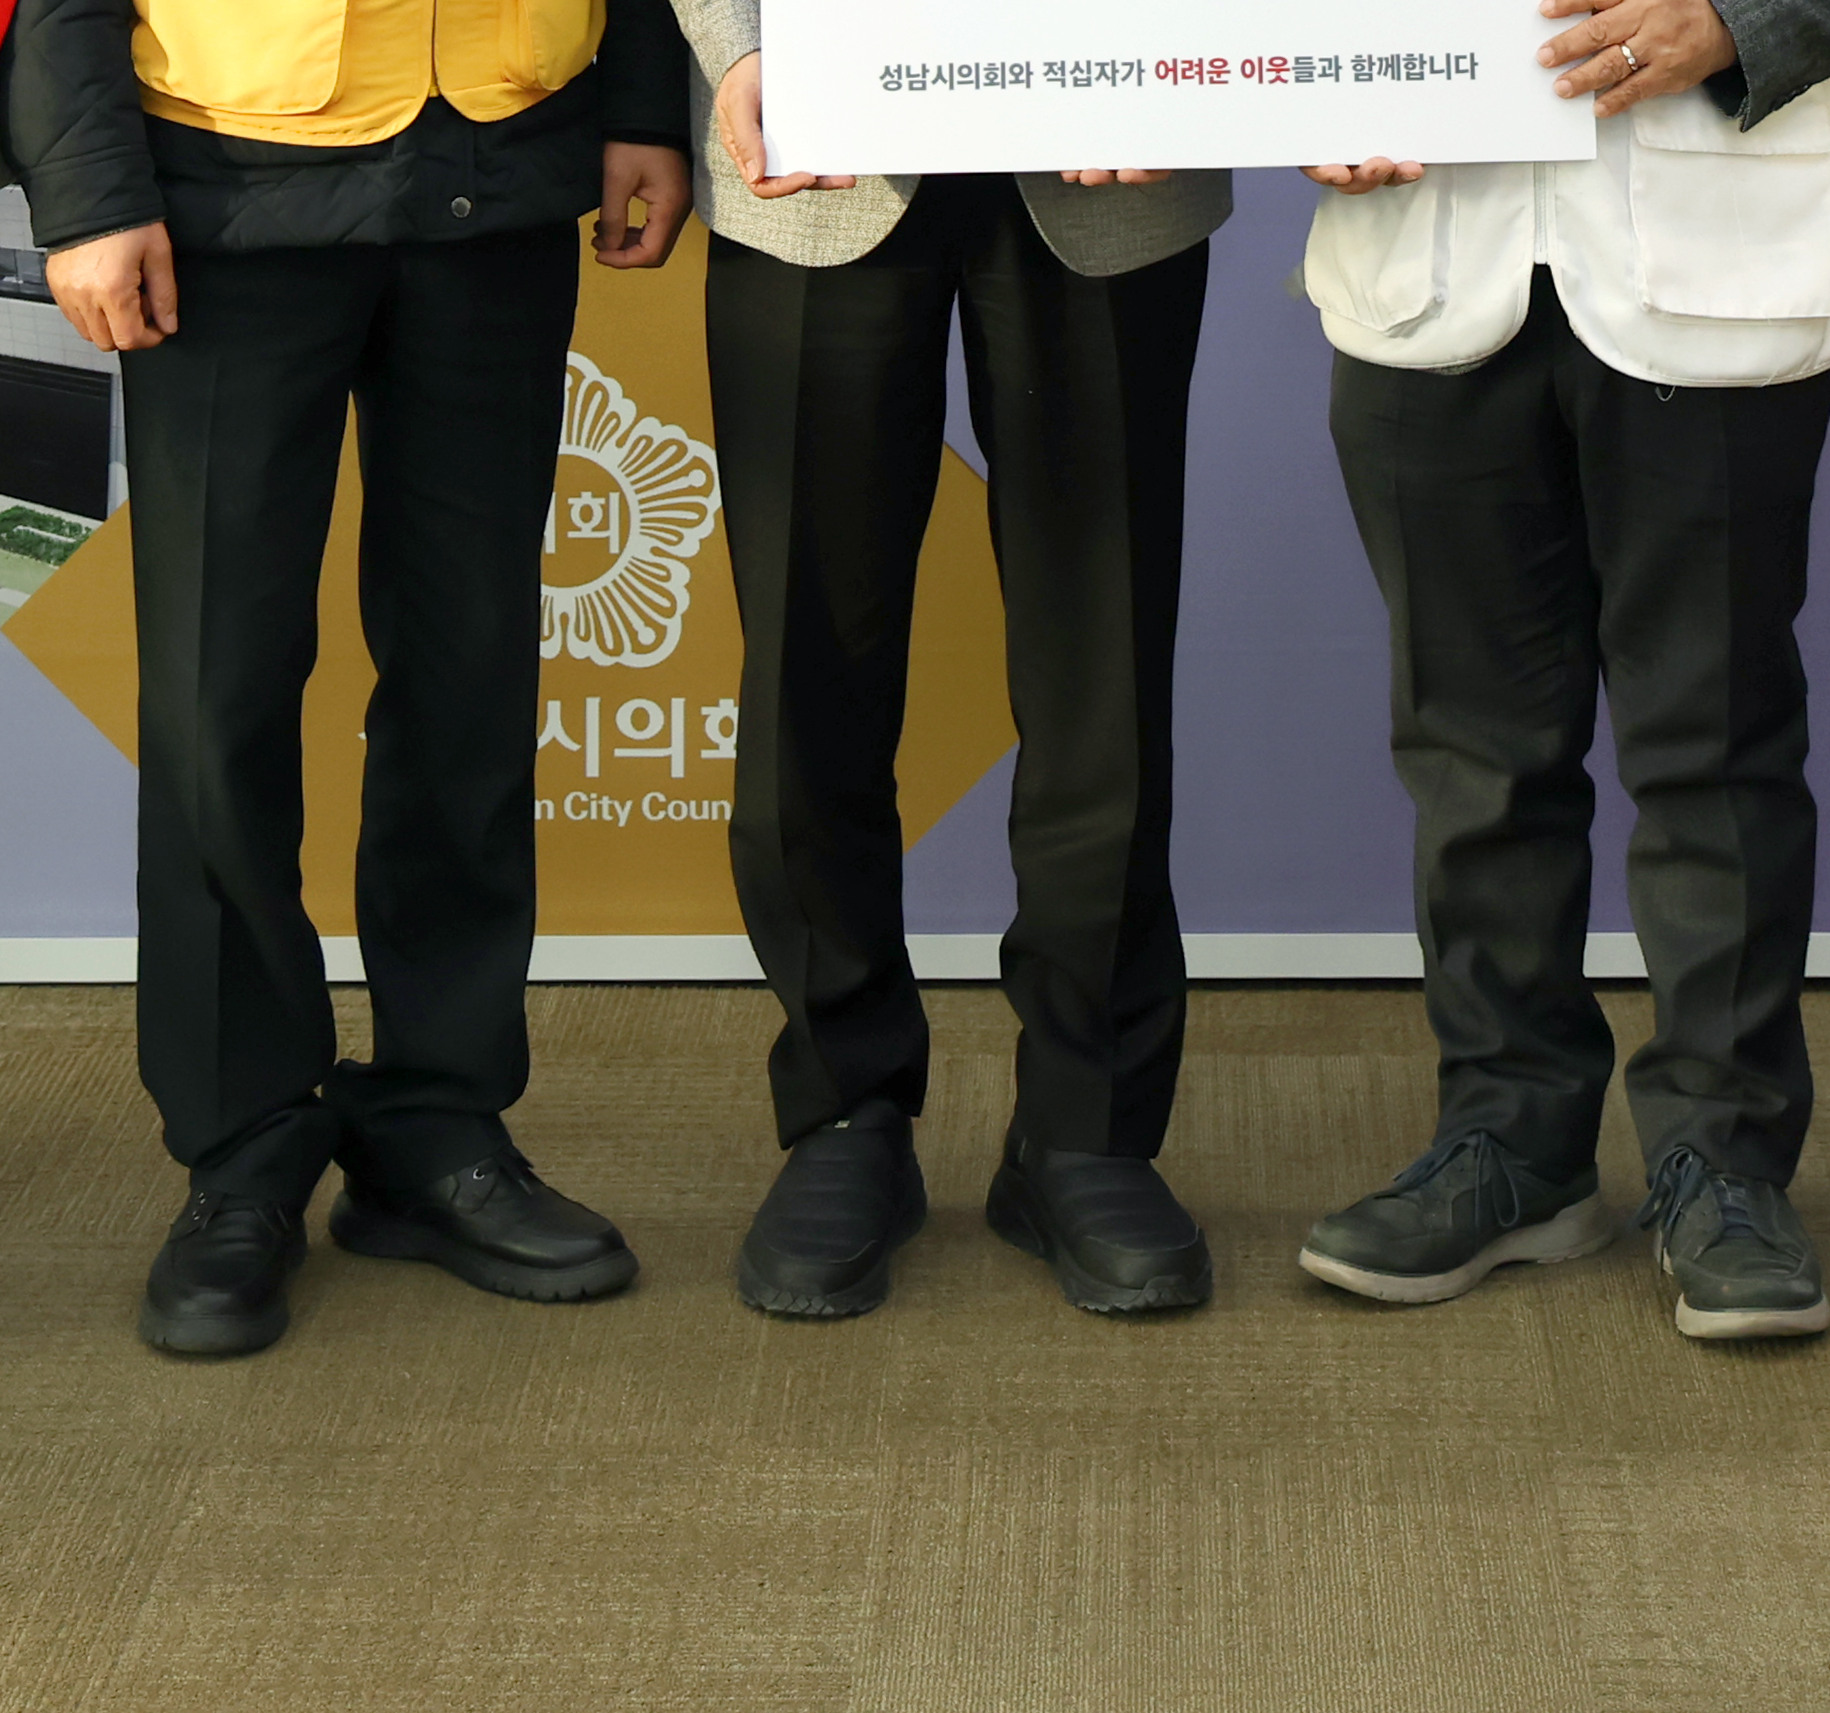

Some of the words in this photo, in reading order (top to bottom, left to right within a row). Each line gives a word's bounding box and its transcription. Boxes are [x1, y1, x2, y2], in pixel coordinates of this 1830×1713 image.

[879, 61, 1034, 92] 성남시의회와
[1043, 58, 1146, 88] 적십자가
[1154, 56, 1231, 86] 어려운
[1240, 53, 1342, 85] 이웃들과
[1351, 51, 1478, 83] 함께합니다
[563, 792, 633, 827] City
[642, 792, 731, 821] Coun
